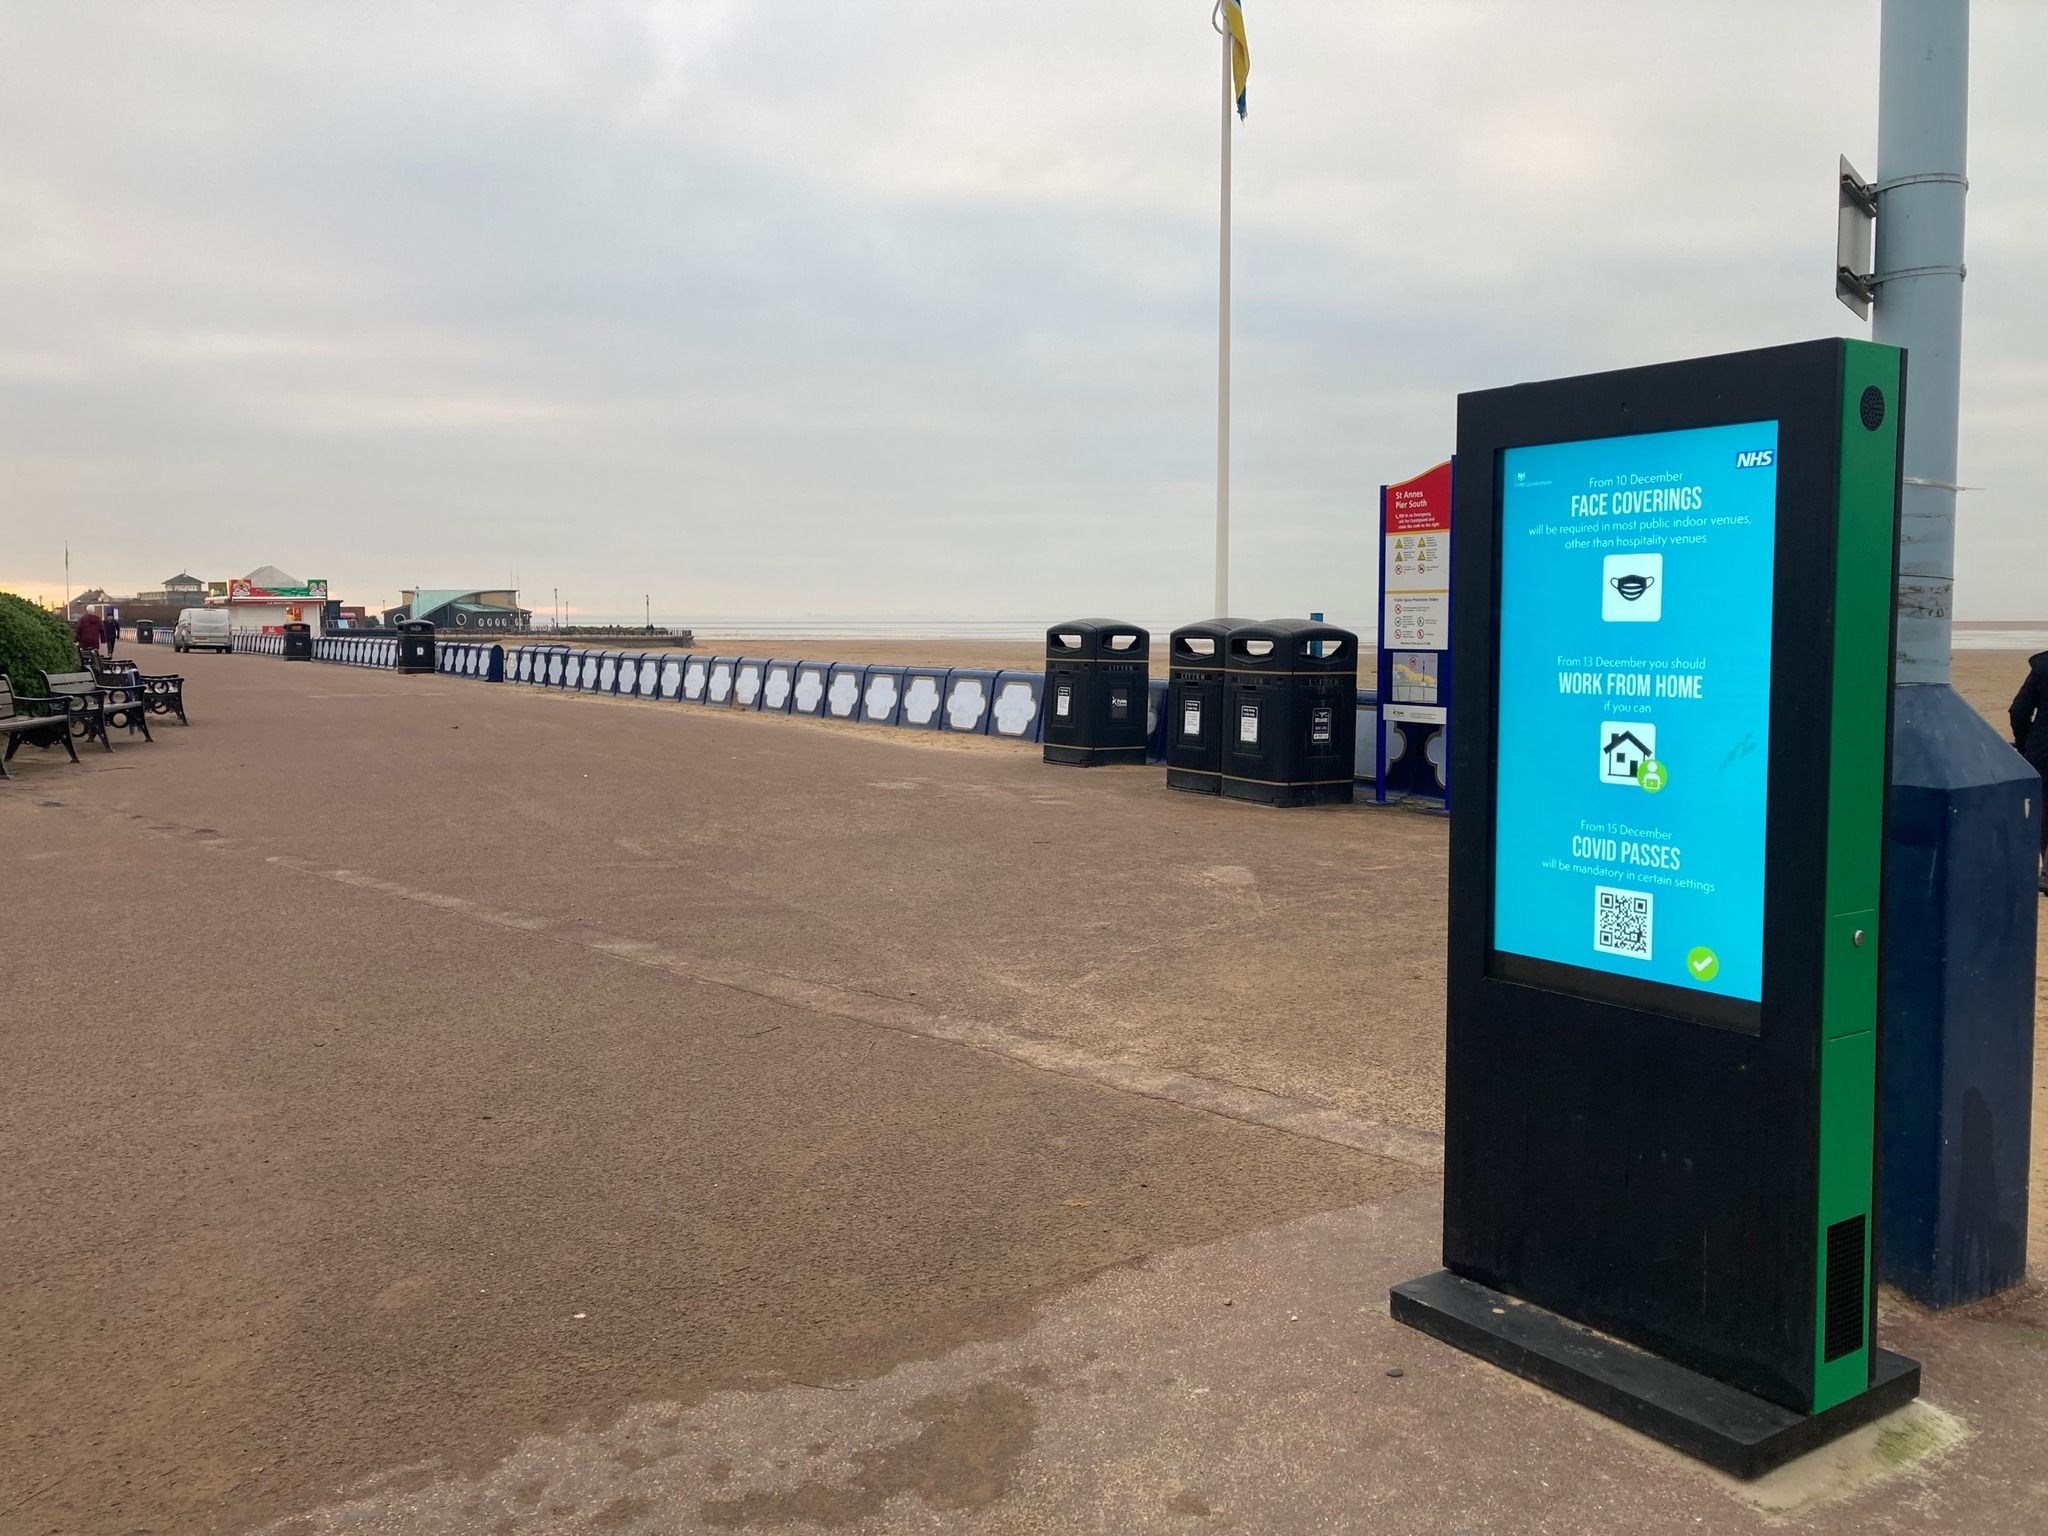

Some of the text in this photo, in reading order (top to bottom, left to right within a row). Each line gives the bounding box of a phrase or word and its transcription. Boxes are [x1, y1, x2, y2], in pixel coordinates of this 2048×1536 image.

[1737, 451, 1773, 468] NHS
[1589, 471, 1683, 488] From 10 December
[1395, 490, 1423, 499] St Annes
[1571, 486, 1702, 517] FACE COVERINGS
[1395, 499, 1427, 509] Pier South
[1529, 522, 1543, 535] will
[1545, 521, 1558, 534] be
[1559, 521, 1599, 535] required
[1601, 521, 1610, 531] in
[1612, 520, 1637, 530] most
[1639, 516, 1670, 531] public
[1673, 514, 1707, 528] indoor
[1565, 534, 1707, 550] other than hospitality venues
[1557, 656, 1706, 671] From 13 December you should
[1558, 672, 1703, 699] WORK FROM HOME
[1604, 700, 1651, 715] if you can
[1581, 820, 1672, 840] From 15 December
[1572, 835, 1681, 871] COVID PASSES
[1542, 858, 1715, 895] will be mandatory in certain settings
